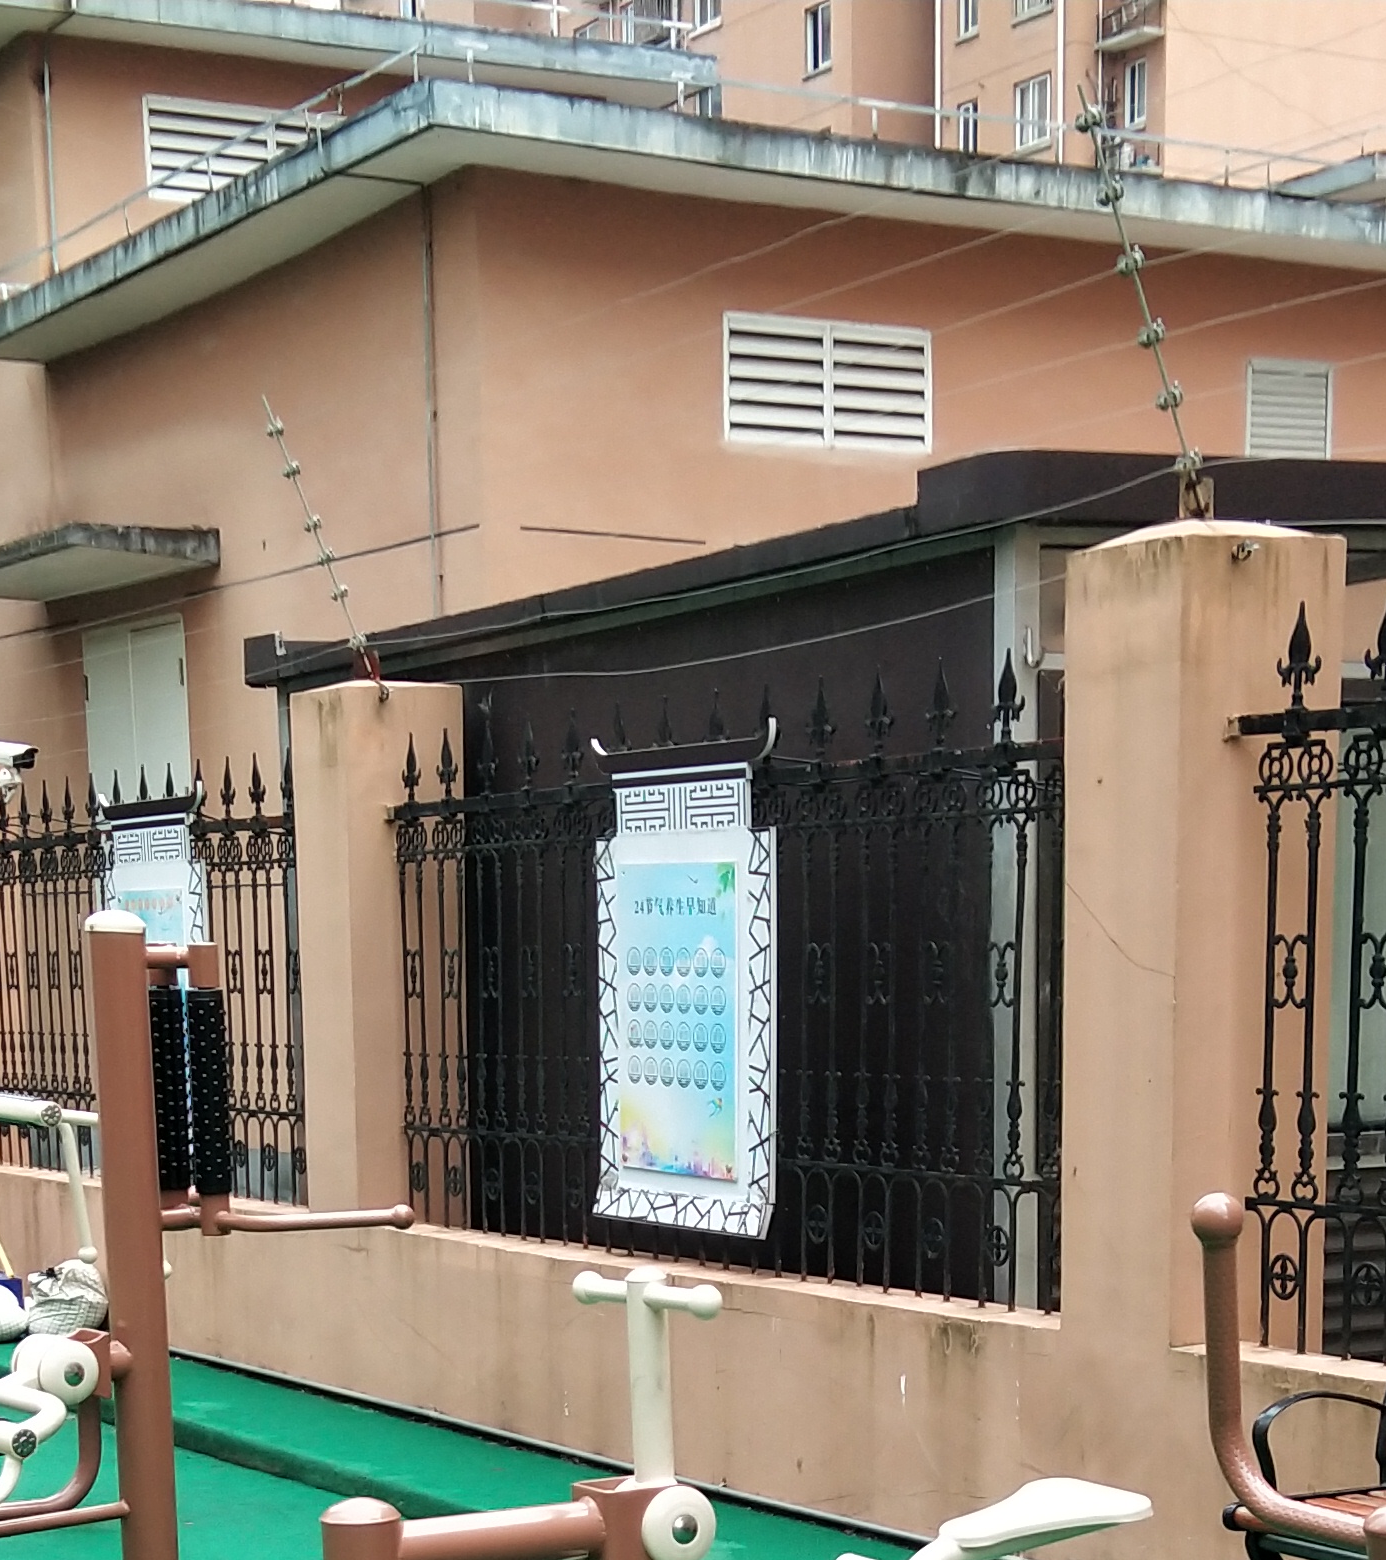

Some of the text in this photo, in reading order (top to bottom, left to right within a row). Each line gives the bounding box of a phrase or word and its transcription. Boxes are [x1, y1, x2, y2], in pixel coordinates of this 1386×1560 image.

[634, 896, 717, 916] 24节气养生早知道
